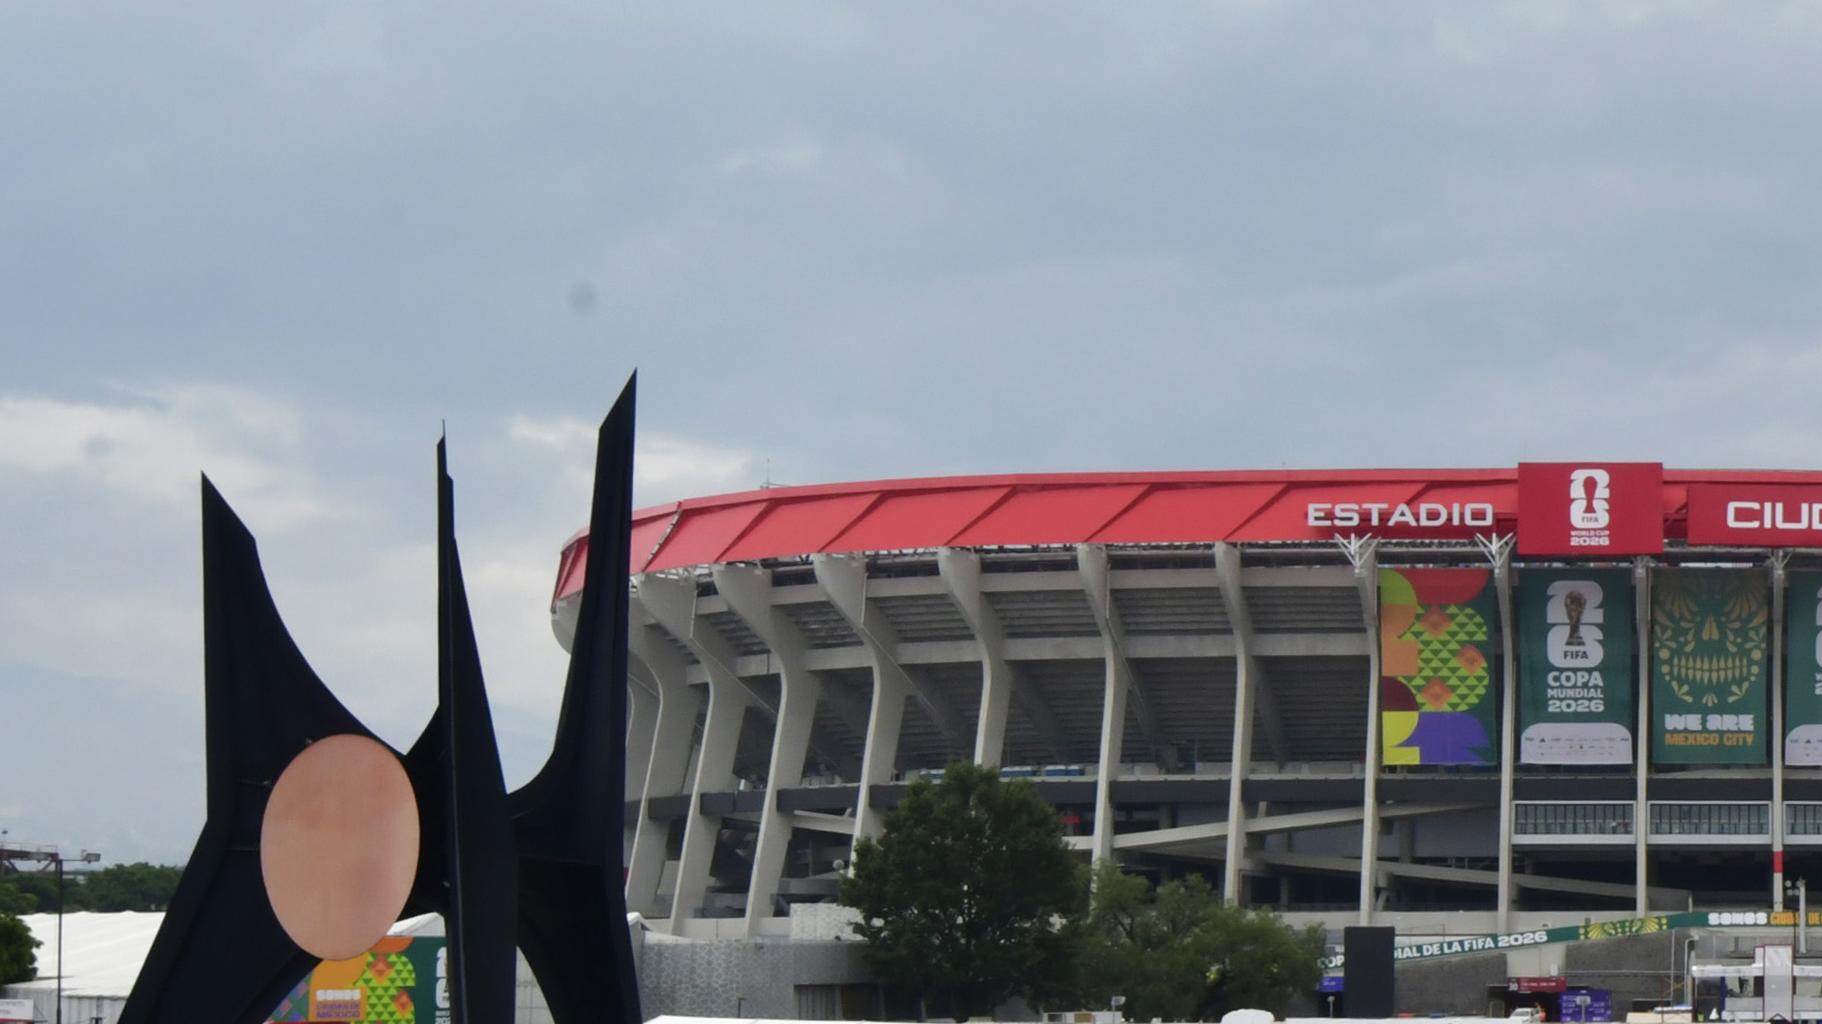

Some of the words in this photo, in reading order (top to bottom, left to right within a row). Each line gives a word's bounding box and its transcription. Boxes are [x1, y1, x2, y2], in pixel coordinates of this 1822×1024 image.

[1307, 503, 1494, 527] ESTADIO
[1570, 536, 1610, 546] 2026
[1563, 650, 1588, 660] FIFA
[1547, 671, 1604, 687] COPA
[1547, 688, 1604, 698] MUNDIAL
[1547, 700, 1605, 713] 2026
[1664, 714, 1702, 730] WE
[1706, 714, 1754, 731] ARE
[1708, 912, 1767, 925] SOMOS
[1394, 946, 1420, 959] IAL
[1423, 943, 1441, 957] DE
[1443, 941, 1462, 954] LA
[1463, 936, 1495, 952] FIFA
[1497, 931, 1548, 947] 2026
